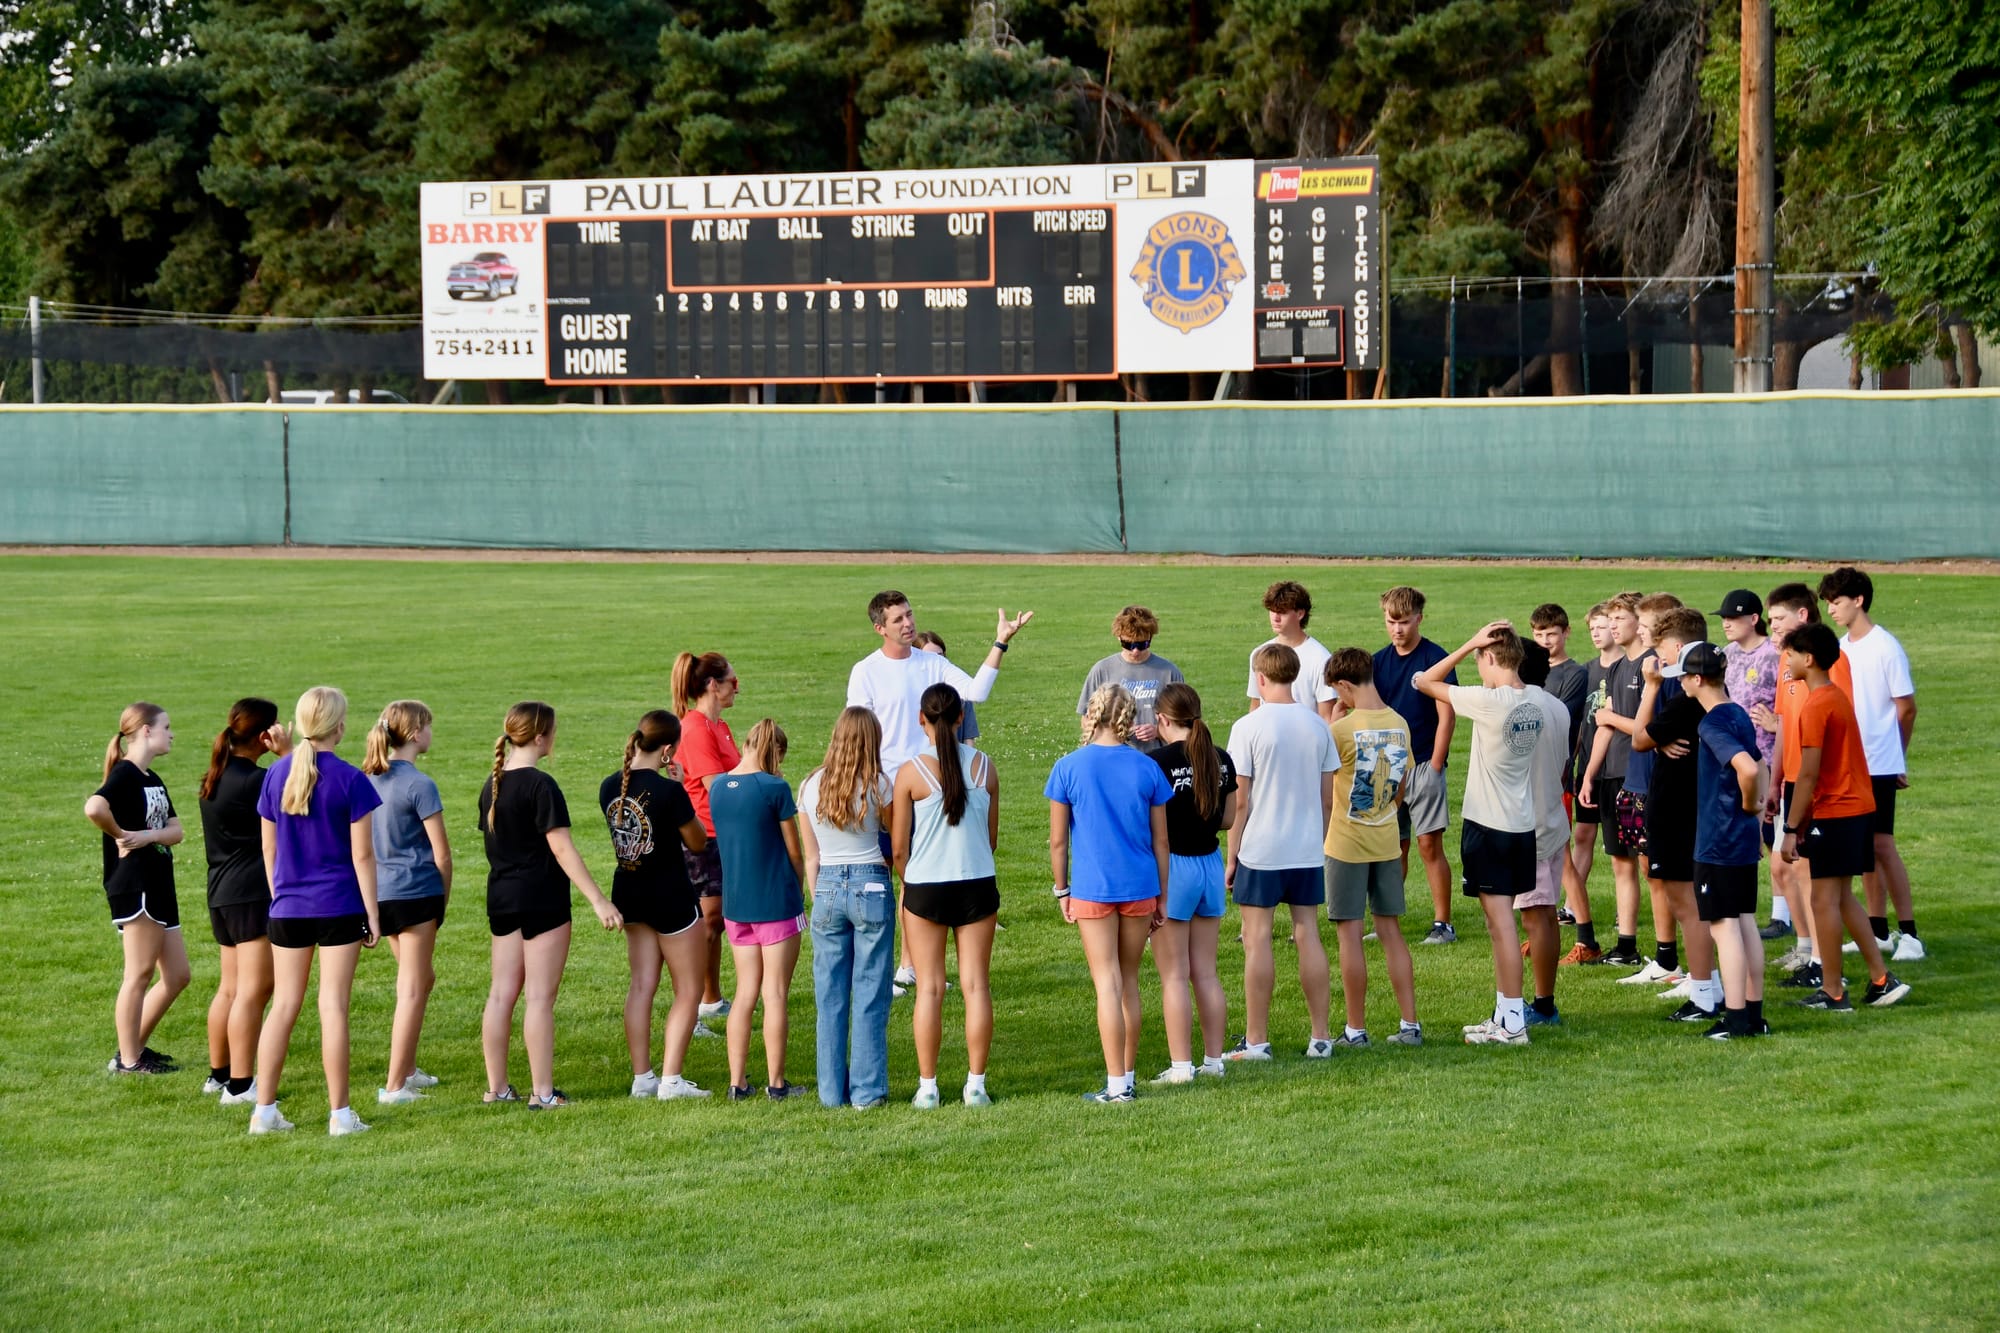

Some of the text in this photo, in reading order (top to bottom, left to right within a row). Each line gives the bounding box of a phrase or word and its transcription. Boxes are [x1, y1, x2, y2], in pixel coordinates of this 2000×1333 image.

[1112, 169, 1200, 193] PLF
[1271, 172, 1368, 193] Tires LES SCHWAB
[469, 187, 546, 211] PLF
[584, 176, 1072, 212] PAUL LAUZIER FOUNDATION
[427, 222, 538, 244] BARRY
[578, 222, 620, 243] TIME
[691, 218, 749, 241] AT BAT
[778, 218, 823, 240] BALL
[852, 215, 915, 238] STRIKE
[948, 212, 985, 236] OUT
[1033, 209, 1107, 233] PITCH SPEED
[1156, 216, 1221, 241] LIONS
[1269, 208, 1283, 280] HOME
[1311, 207, 1326, 300] GUEST
[1176, 249, 1204, 291] L
[1354, 205, 1368, 365] PITCH COUNT
[655, 285, 1095, 312] 1 2 3 4 5 6 7 8 9 10 RUNS HITS ERR
[1266, 309, 1328, 320] PITCH COUNT
[1308, 319, 1330, 327] GUEST
[560, 314, 631, 341] GUEST
[435, 340, 534, 355] 754-2411
[564, 348, 627, 375] HOME
[1519, 721, 1537, 731] YETI
